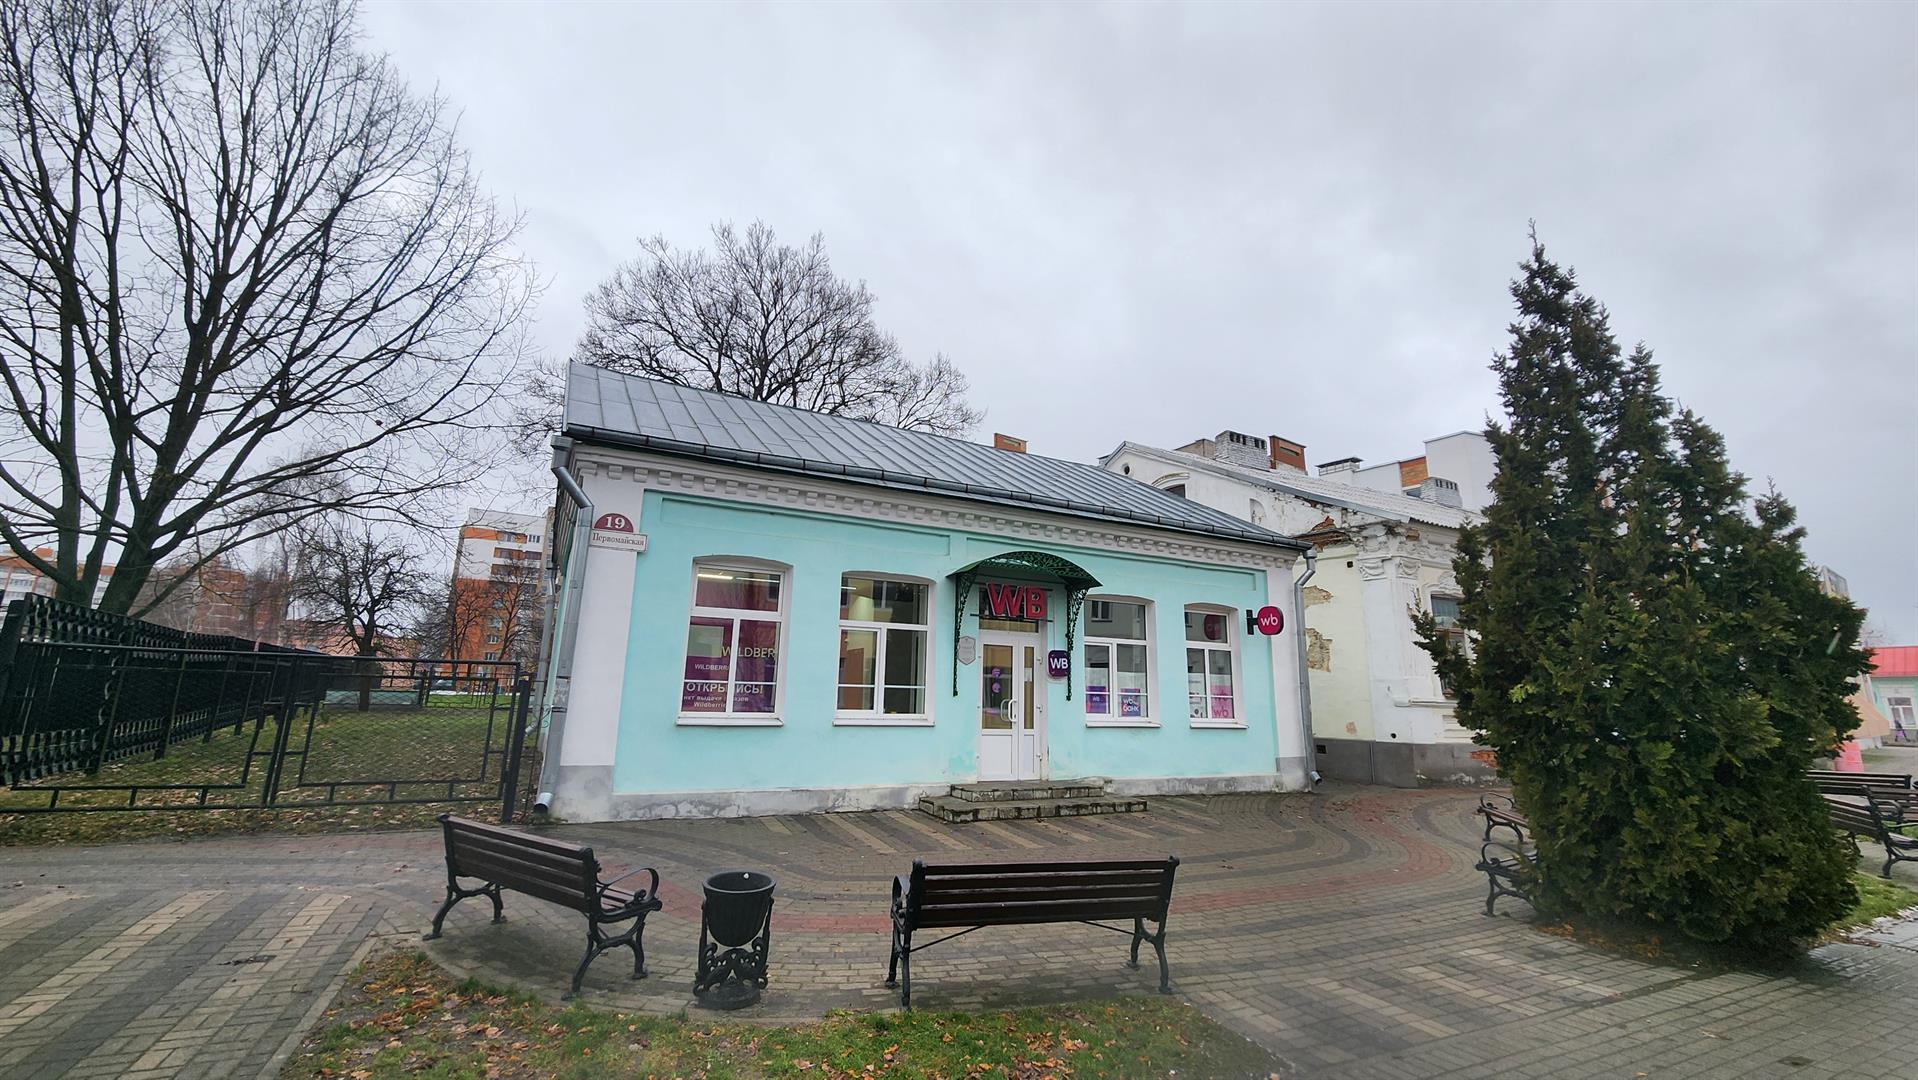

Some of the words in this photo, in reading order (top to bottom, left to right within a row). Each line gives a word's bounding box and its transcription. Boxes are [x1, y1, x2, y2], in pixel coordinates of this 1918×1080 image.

[606, 516, 625, 529] 19
[592, 532, 645, 546] Первомайская
[987, 583, 1047, 619] WB
[1260, 613, 1278, 626] wb
[722, 646, 776, 658] WLDBER
[1050, 658, 1068, 669] WB
